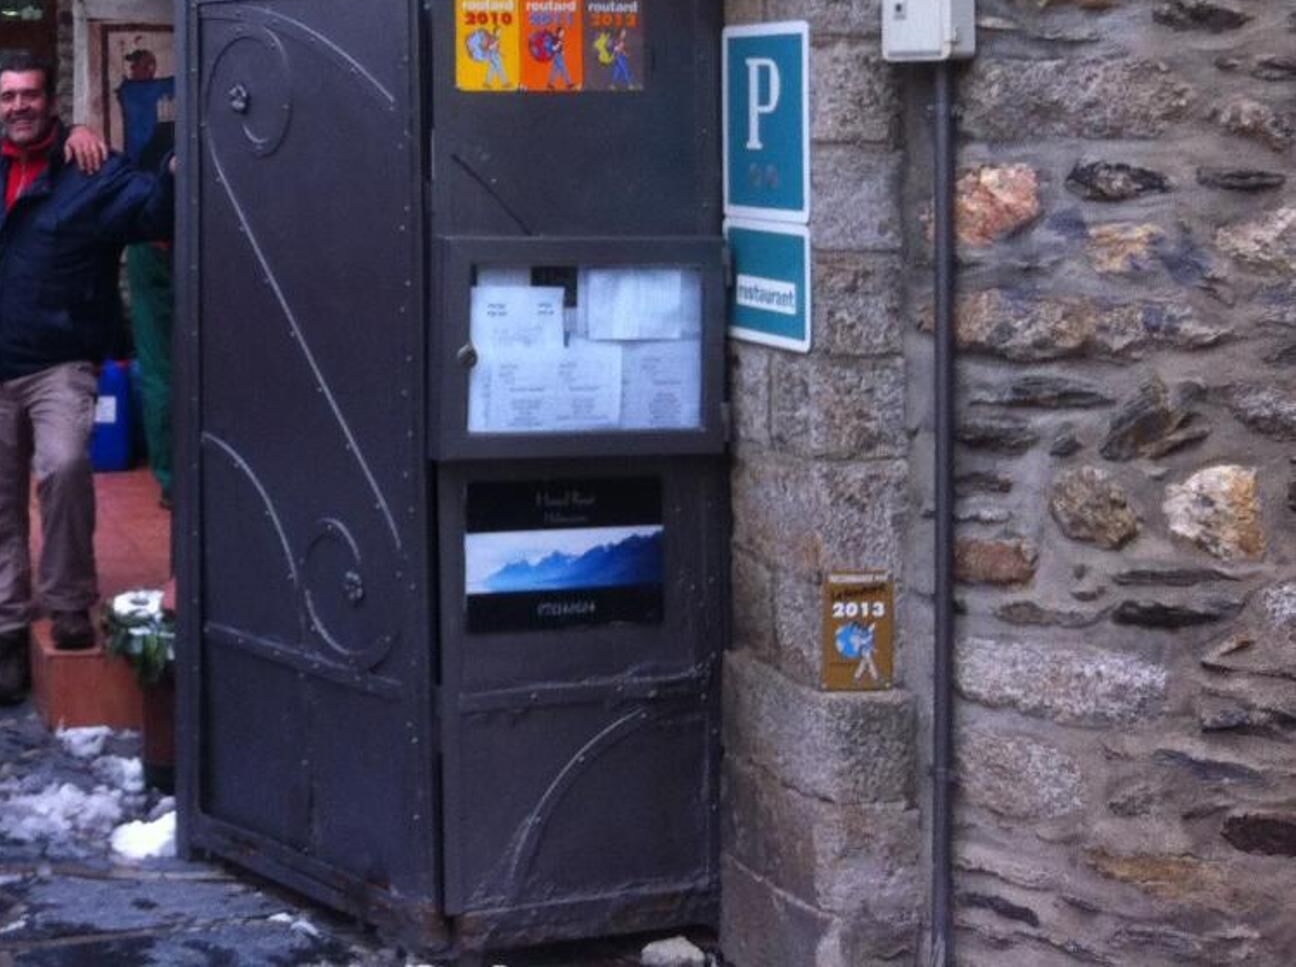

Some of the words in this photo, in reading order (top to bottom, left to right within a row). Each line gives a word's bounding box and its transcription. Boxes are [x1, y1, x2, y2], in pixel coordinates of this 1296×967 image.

[588, 0, 639, 13] routard
[465, 12, 513, 26] 2010
[745, 57, 781, 150] P
[832, 601, 885, 618] 2013
